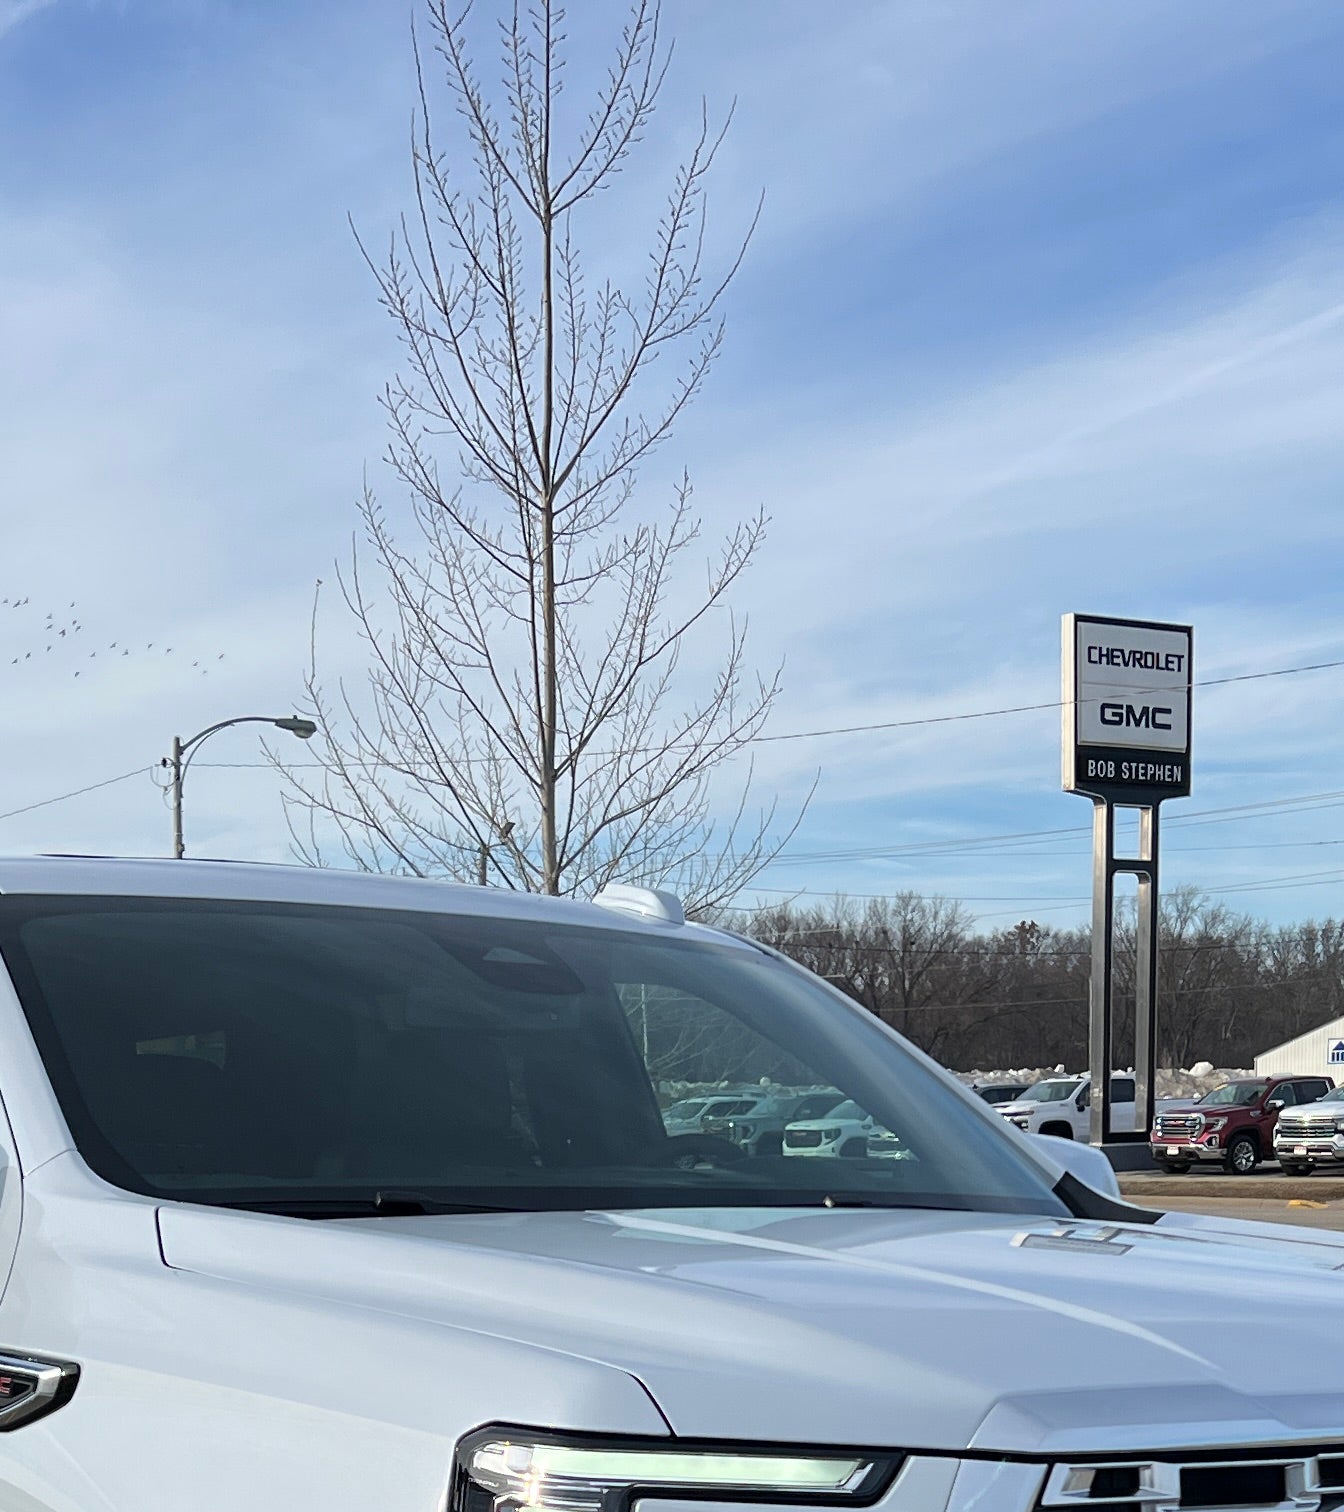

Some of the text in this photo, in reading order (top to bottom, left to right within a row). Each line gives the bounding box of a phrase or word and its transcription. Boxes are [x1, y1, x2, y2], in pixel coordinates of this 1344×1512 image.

[1088, 646, 1184, 672] CHEVROLET
[1100, 703, 1172, 730] GMC
[1088, 760, 1182, 782] BOB STEPHEN
